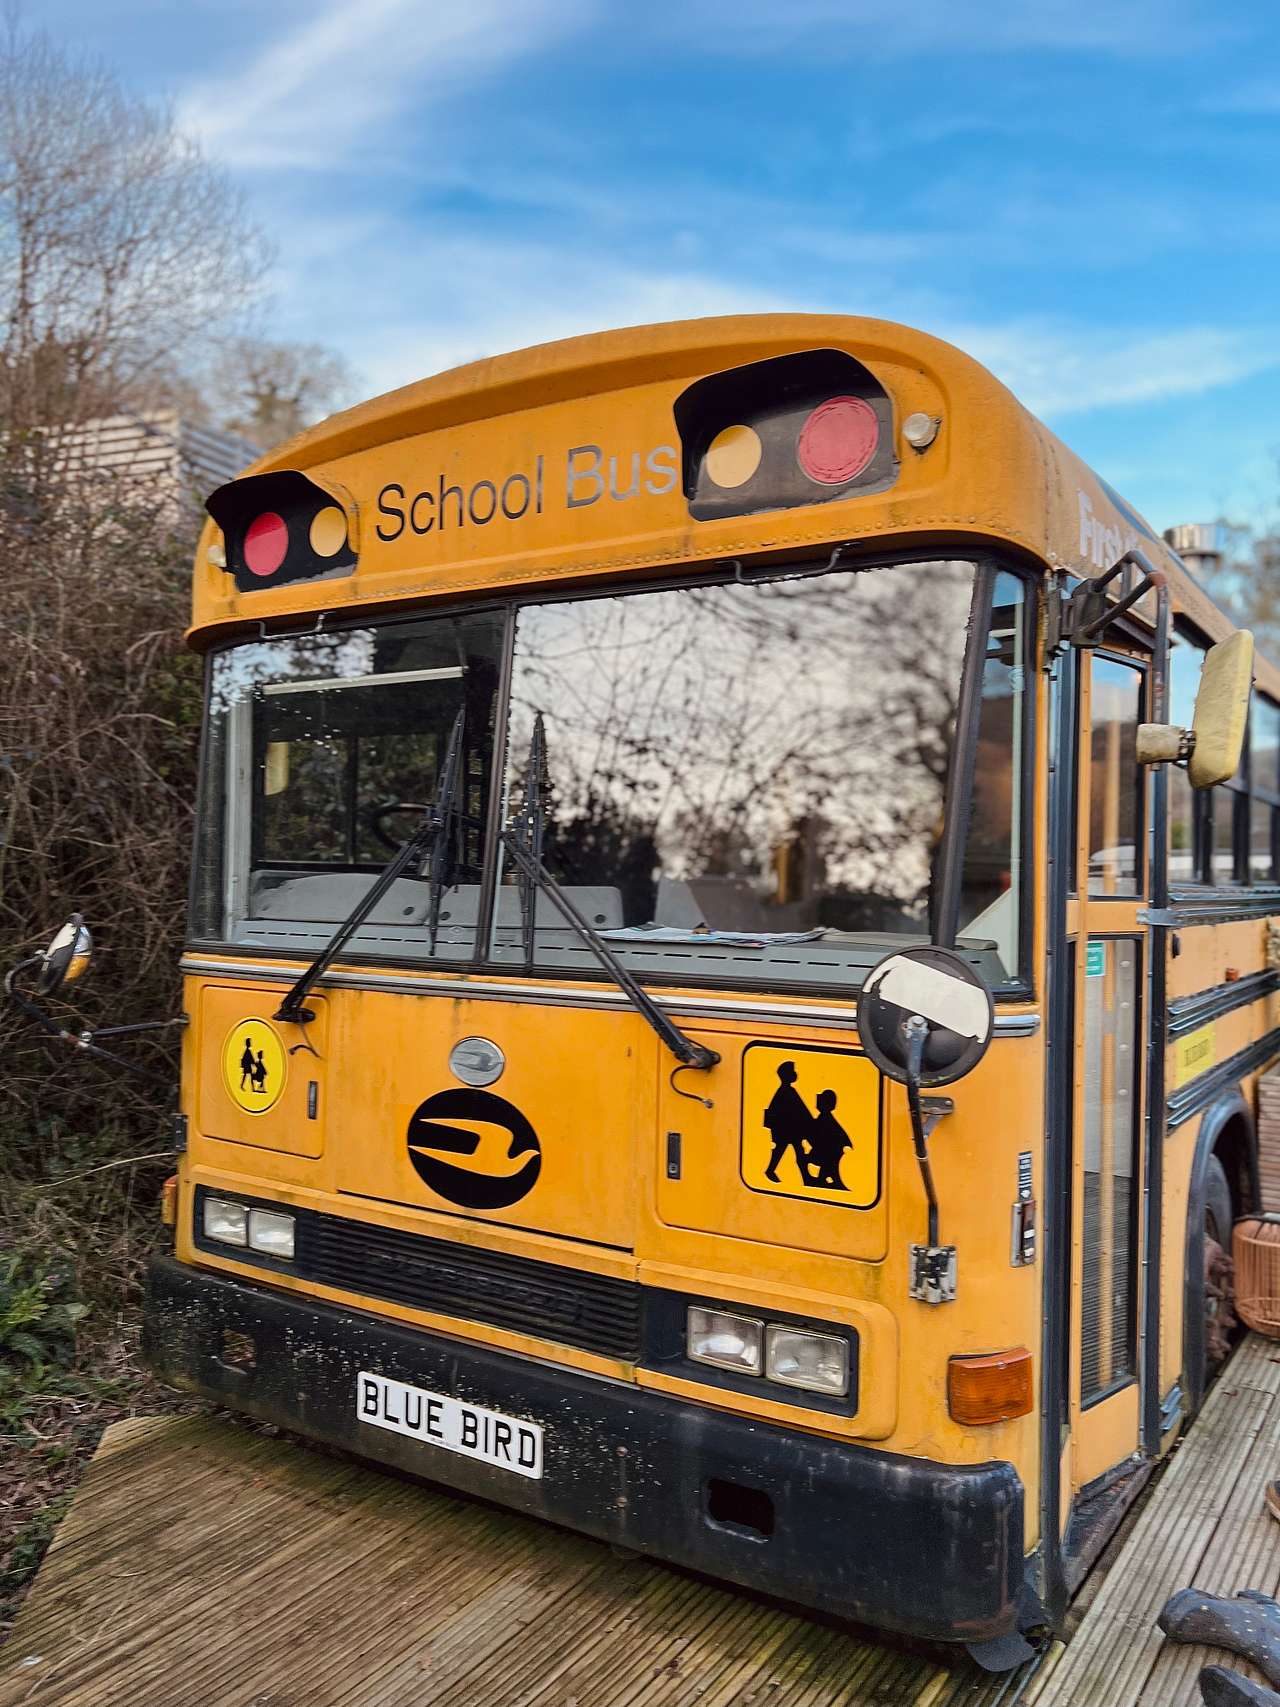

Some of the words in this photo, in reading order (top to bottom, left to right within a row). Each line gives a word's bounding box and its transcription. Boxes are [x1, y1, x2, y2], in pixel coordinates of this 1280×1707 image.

[376, 455, 543, 542] School
[566, 445, 677, 509] Bus
[363, 1379, 443, 1438] BLUE
[461, 1409, 536, 1469] BIRD
